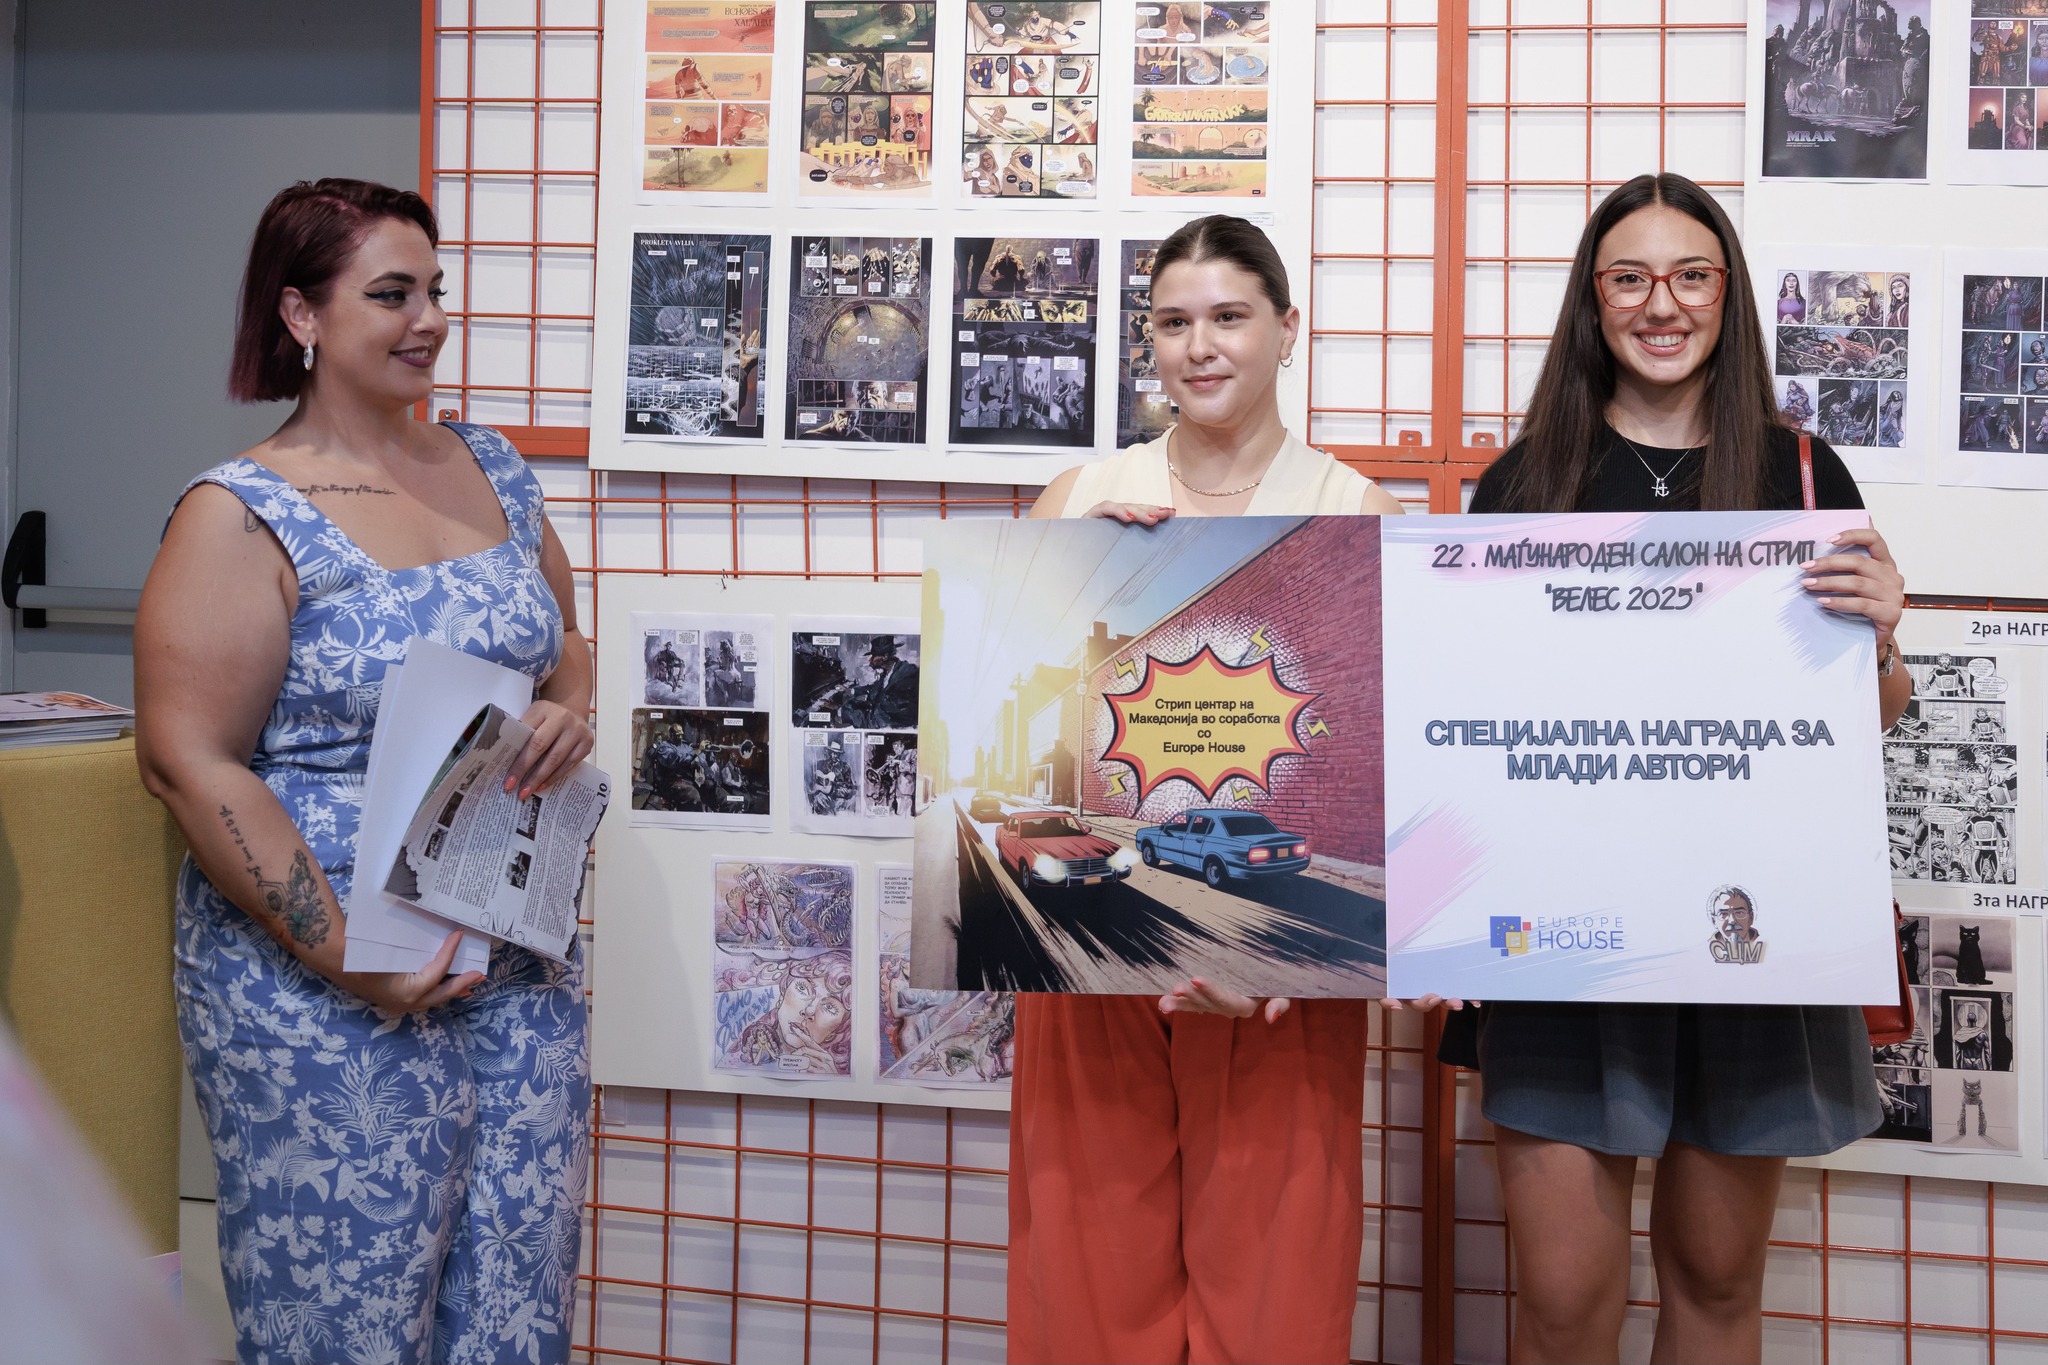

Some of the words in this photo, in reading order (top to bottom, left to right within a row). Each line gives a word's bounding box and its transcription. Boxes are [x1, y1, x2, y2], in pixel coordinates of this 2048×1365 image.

[724, 7, 759, 16] ECHOES
[1786, 130, 1837, 142] MRAK
[1640, 540, 1710, 568] САЛОН
[1714, 540, 1744, 568] НА
[1748, 540, 1816, 567] СТРИП
[1544, 583, 1621, 613] "ВЕЛЕС
[1626, 582, 1704, 611] 2025"
[1971, 621, 2001, 638] 2ра
[1155, 698, 1192, 712] Стрип
[1194, 700, 1236, 712] центар
[1239, 700, 1254, 710] на
[1129, 713, 1198, 726] Македонија
[1201, 715, 1216, 724] во
[1218, 713, 1281, 726] соработка
[1197, 729, 1212, 738] со
[1424, 719, 1635, 751] СПЕЦИЈАЛНА
[1640, 719, 1785, 751] НАГРАДА
[1791, 719, 1835, 746] ЗА
[1163, 741, 1205, 755] Europe
[1208, 741, 1246, 753] House
[1507, 754, 1617, 785] МЛАДИ
[1624, 754, 1751, 780] АВТОРИ
[596, 782, 608, 798] 10
[1973, 893, 2001, 908] 3та
[1537, 916, 1624, 928] EUROPE
[1538, 930, 1625, 950] HOUSE
[1709, 940, 1764, 965] СЦМ
